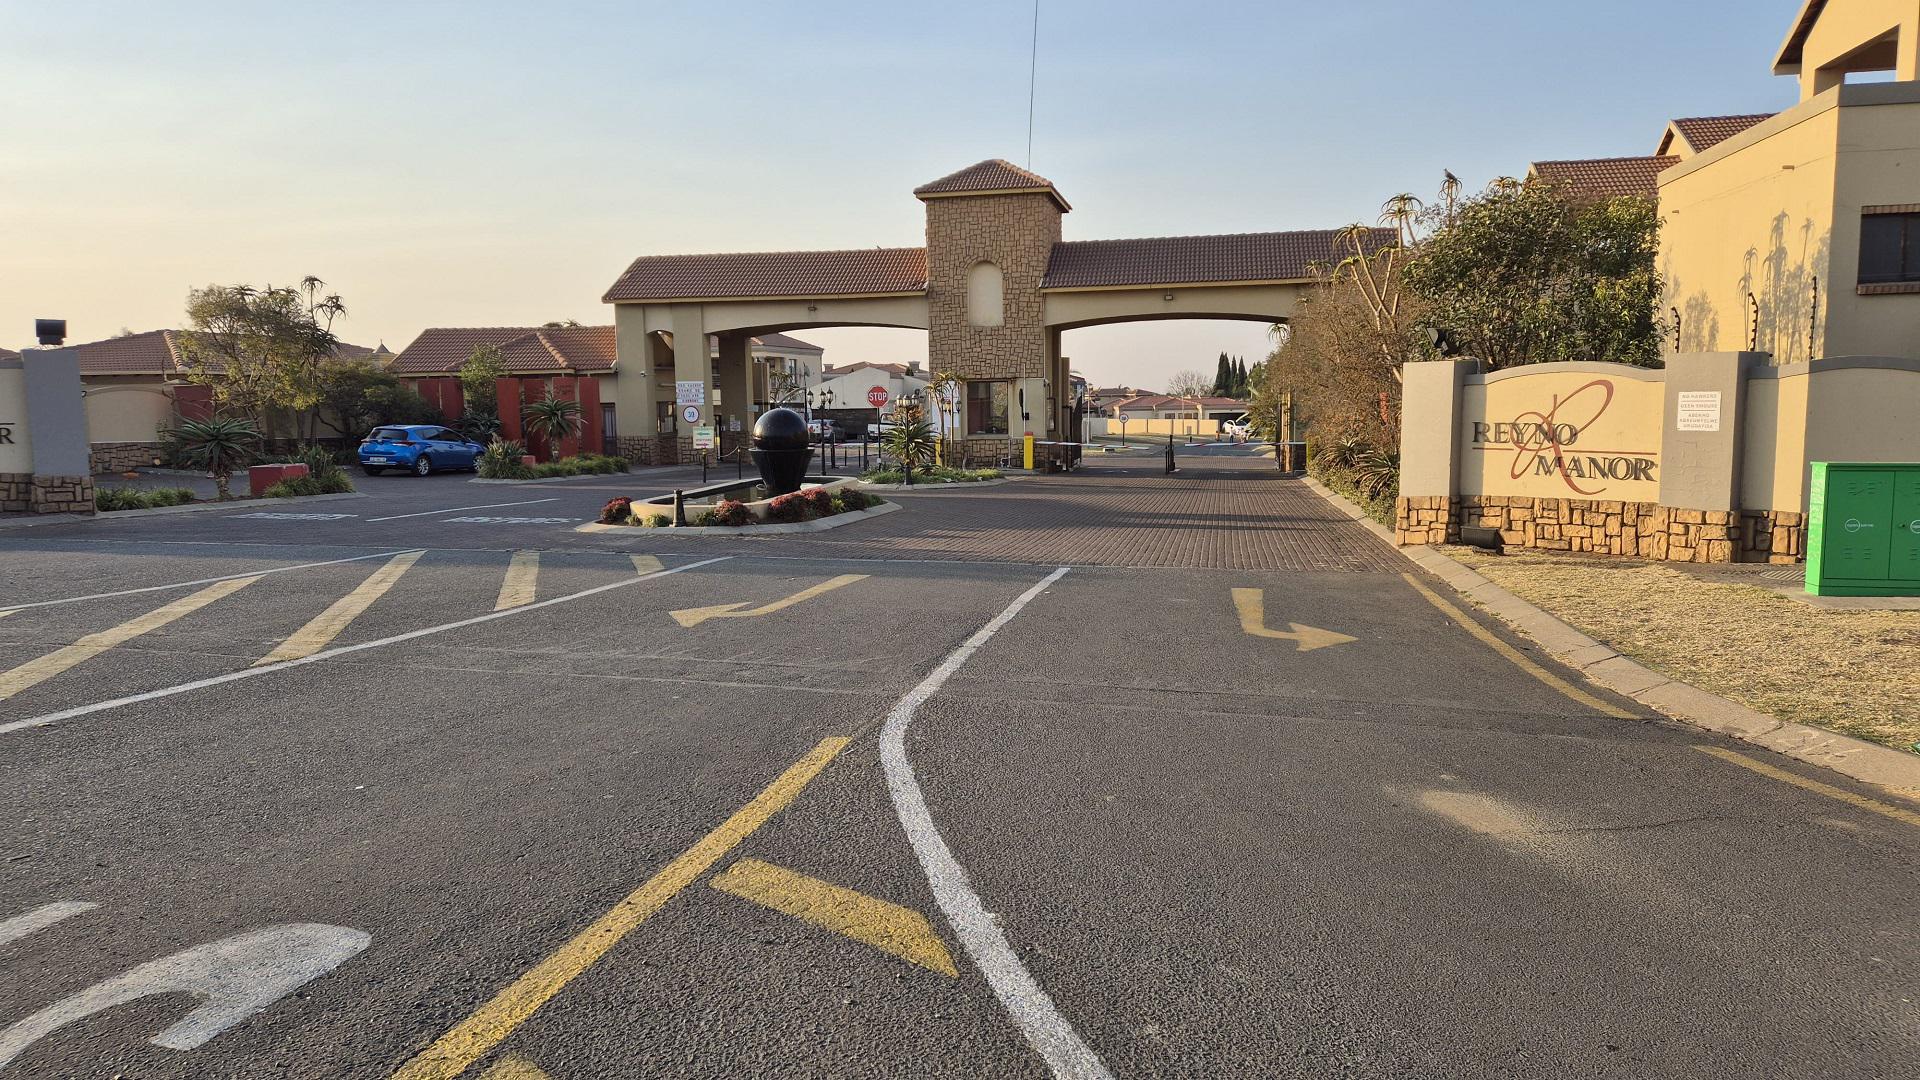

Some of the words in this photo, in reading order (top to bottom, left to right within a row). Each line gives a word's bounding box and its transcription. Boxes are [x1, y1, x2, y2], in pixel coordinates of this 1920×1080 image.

[868, 392, 887, 401] STOP
[1472, 421, 1579, 446] REYNO
[1534, 454, 1658, 482] MANOR
